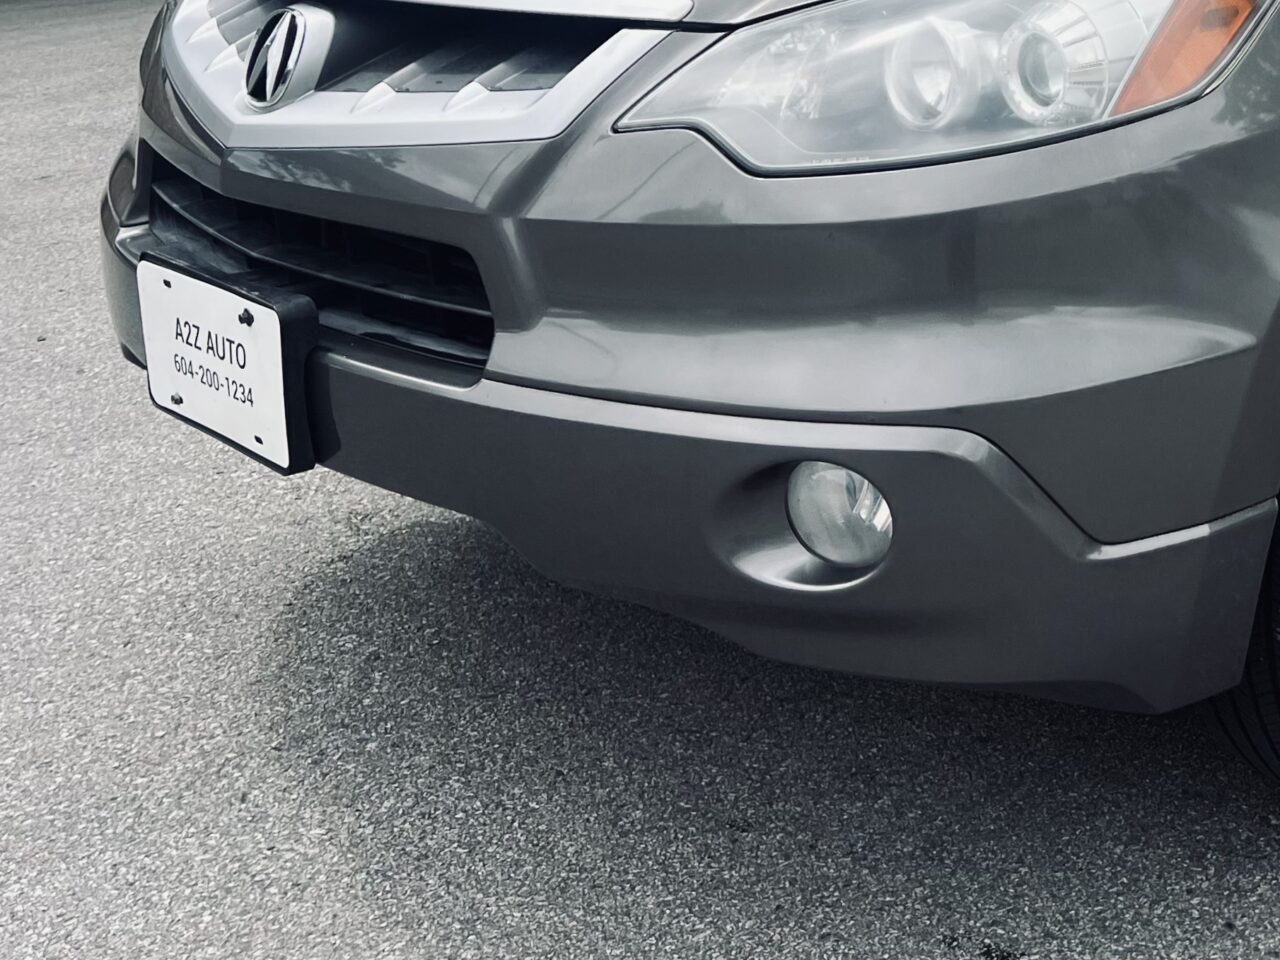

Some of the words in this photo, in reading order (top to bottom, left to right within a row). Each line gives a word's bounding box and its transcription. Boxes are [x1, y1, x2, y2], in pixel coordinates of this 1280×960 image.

[175, 317, 202, 351] A2Z
[206, 330, 247, 370] AUTO
[174, 353, 254, 408] 604-200-1234
